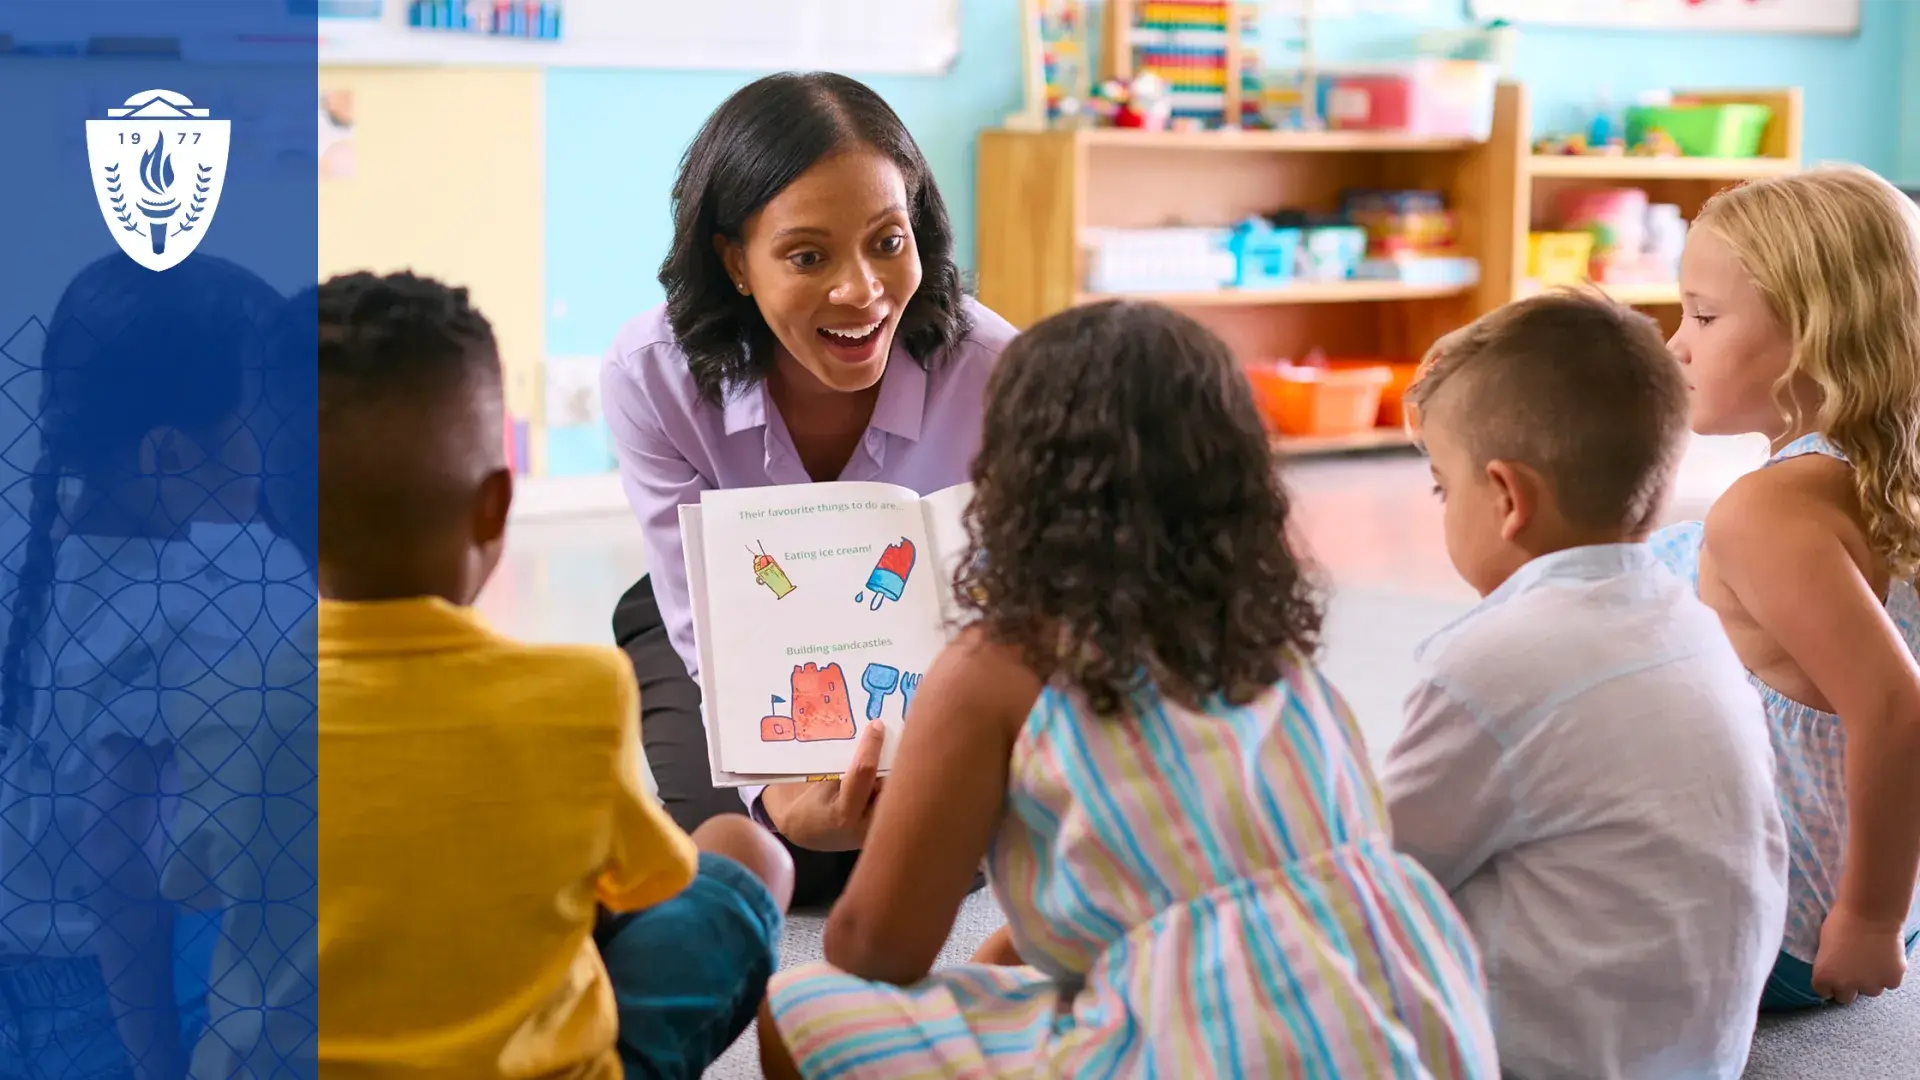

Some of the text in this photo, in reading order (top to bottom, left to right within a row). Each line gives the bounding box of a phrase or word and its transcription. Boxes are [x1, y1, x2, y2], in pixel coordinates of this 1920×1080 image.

[739, 500, 904, 520] Their favourite things to do are...
[784, 544, 872, 561] Eating ice cream!
[786, 637, 893, 656] Building sandcastles
